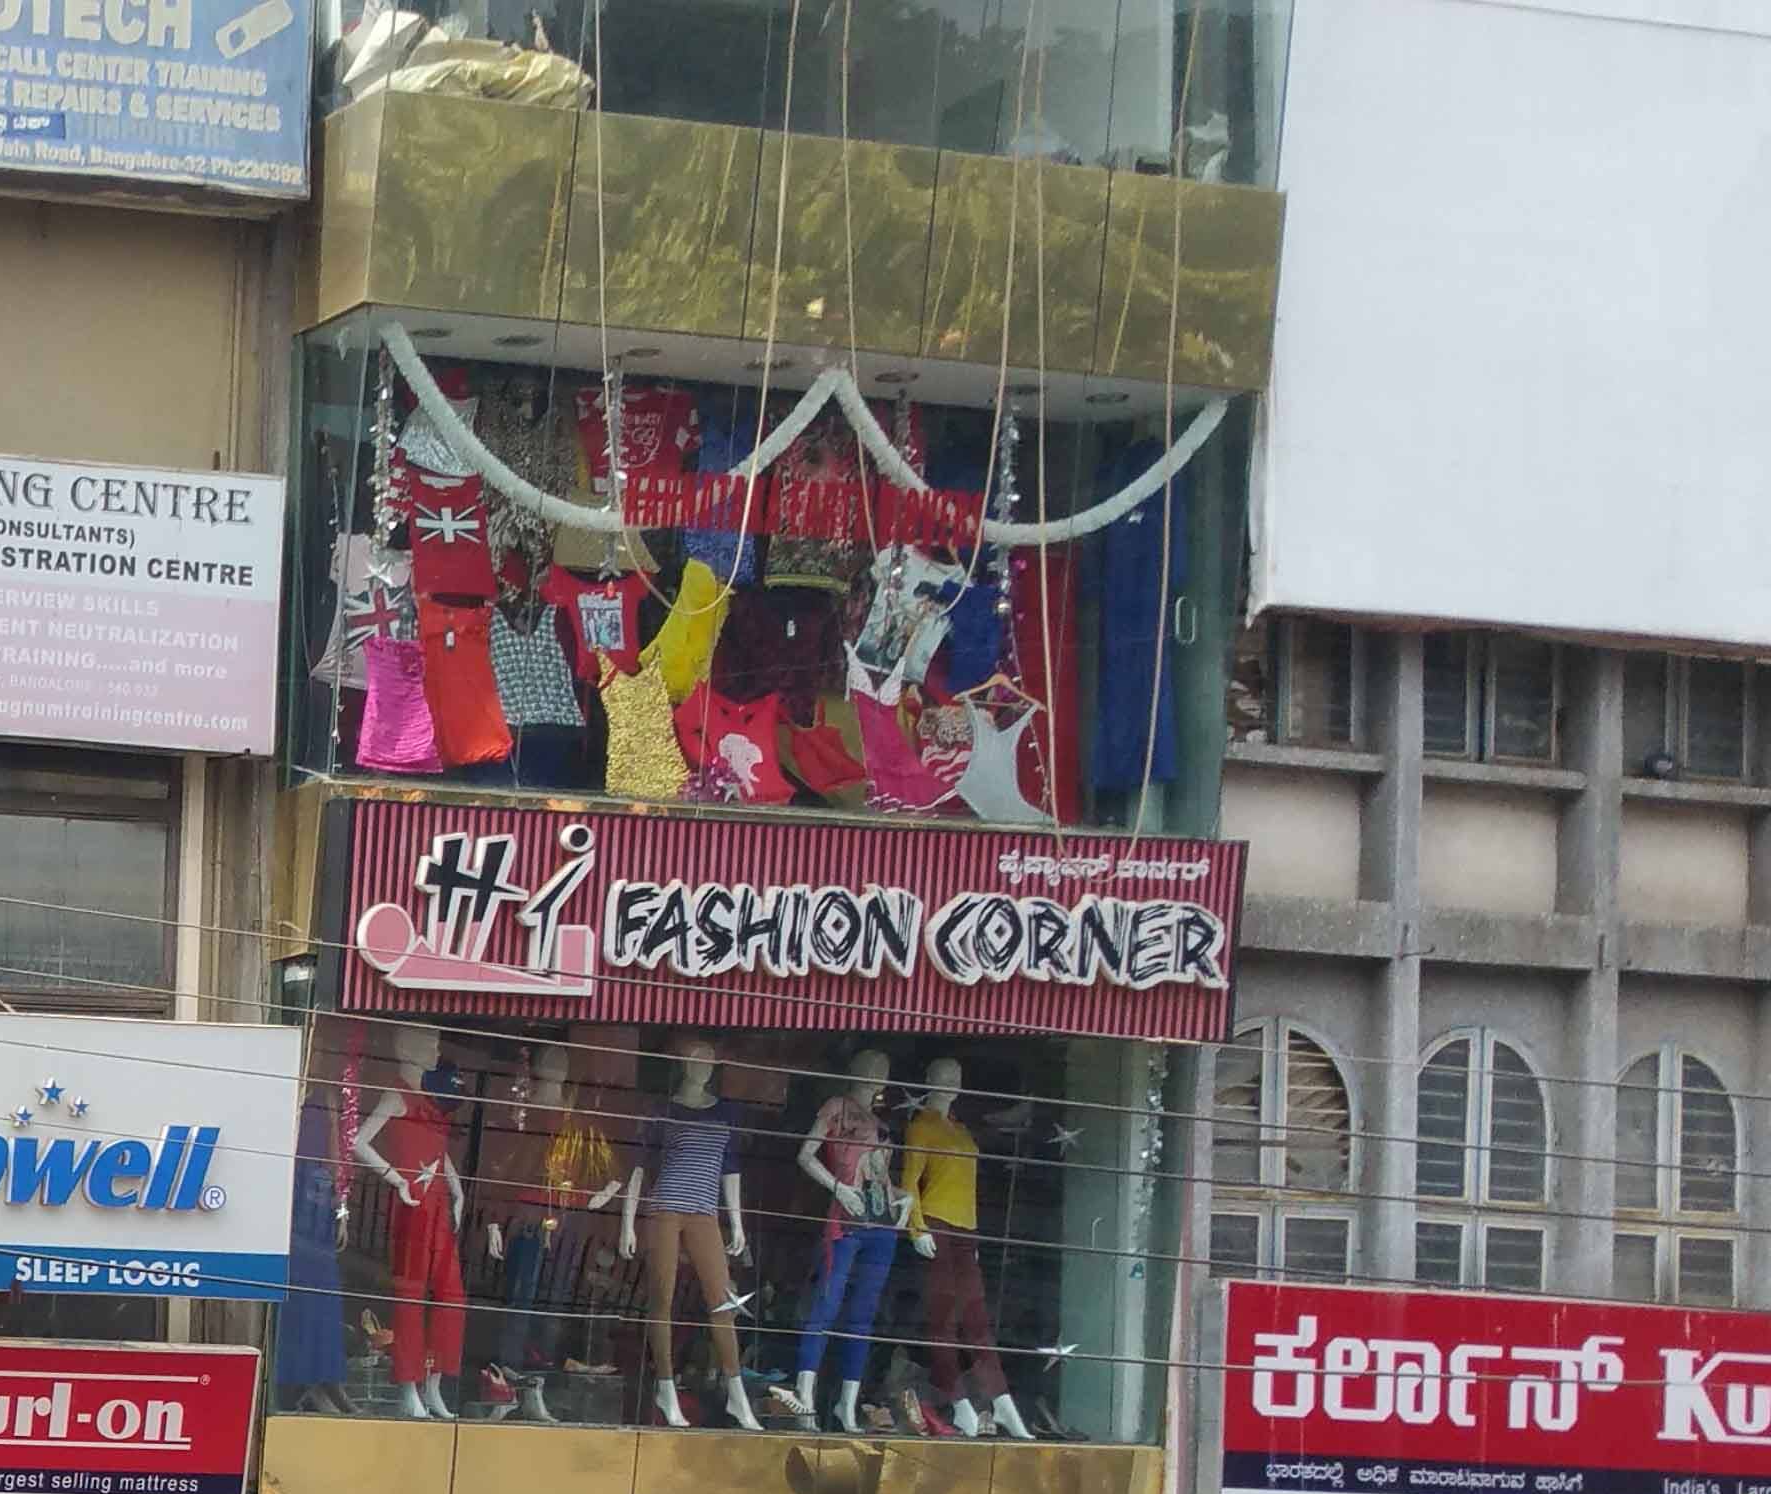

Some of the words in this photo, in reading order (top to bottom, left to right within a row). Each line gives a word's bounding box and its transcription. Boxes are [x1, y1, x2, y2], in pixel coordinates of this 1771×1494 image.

[56, 51, 149, 85] CENTER
[12, 80, 123, 115] REPAIRS
[129, 91, 148, 119] &
[155, 94, 282, 132] SERVICES
[70, 474, 253, 526] CENTRE
[147, 557, 254, 588] CENTRE
[82, 595, 159, 618] SKILLS
[48, 623, 239, 653] NEUTRALIZATION
[175, 662, 229, 680] more
[604, 876, 923, 978] FASHION
[926, 891, 1228, 990] CORNER
[15, 1254, 100, 1286] SLEEP
[108, 1260, 202, 1289] LOGIC
[52, 1474, 112, 1494] selling
[119, 1478, 200, 1494] mattress
